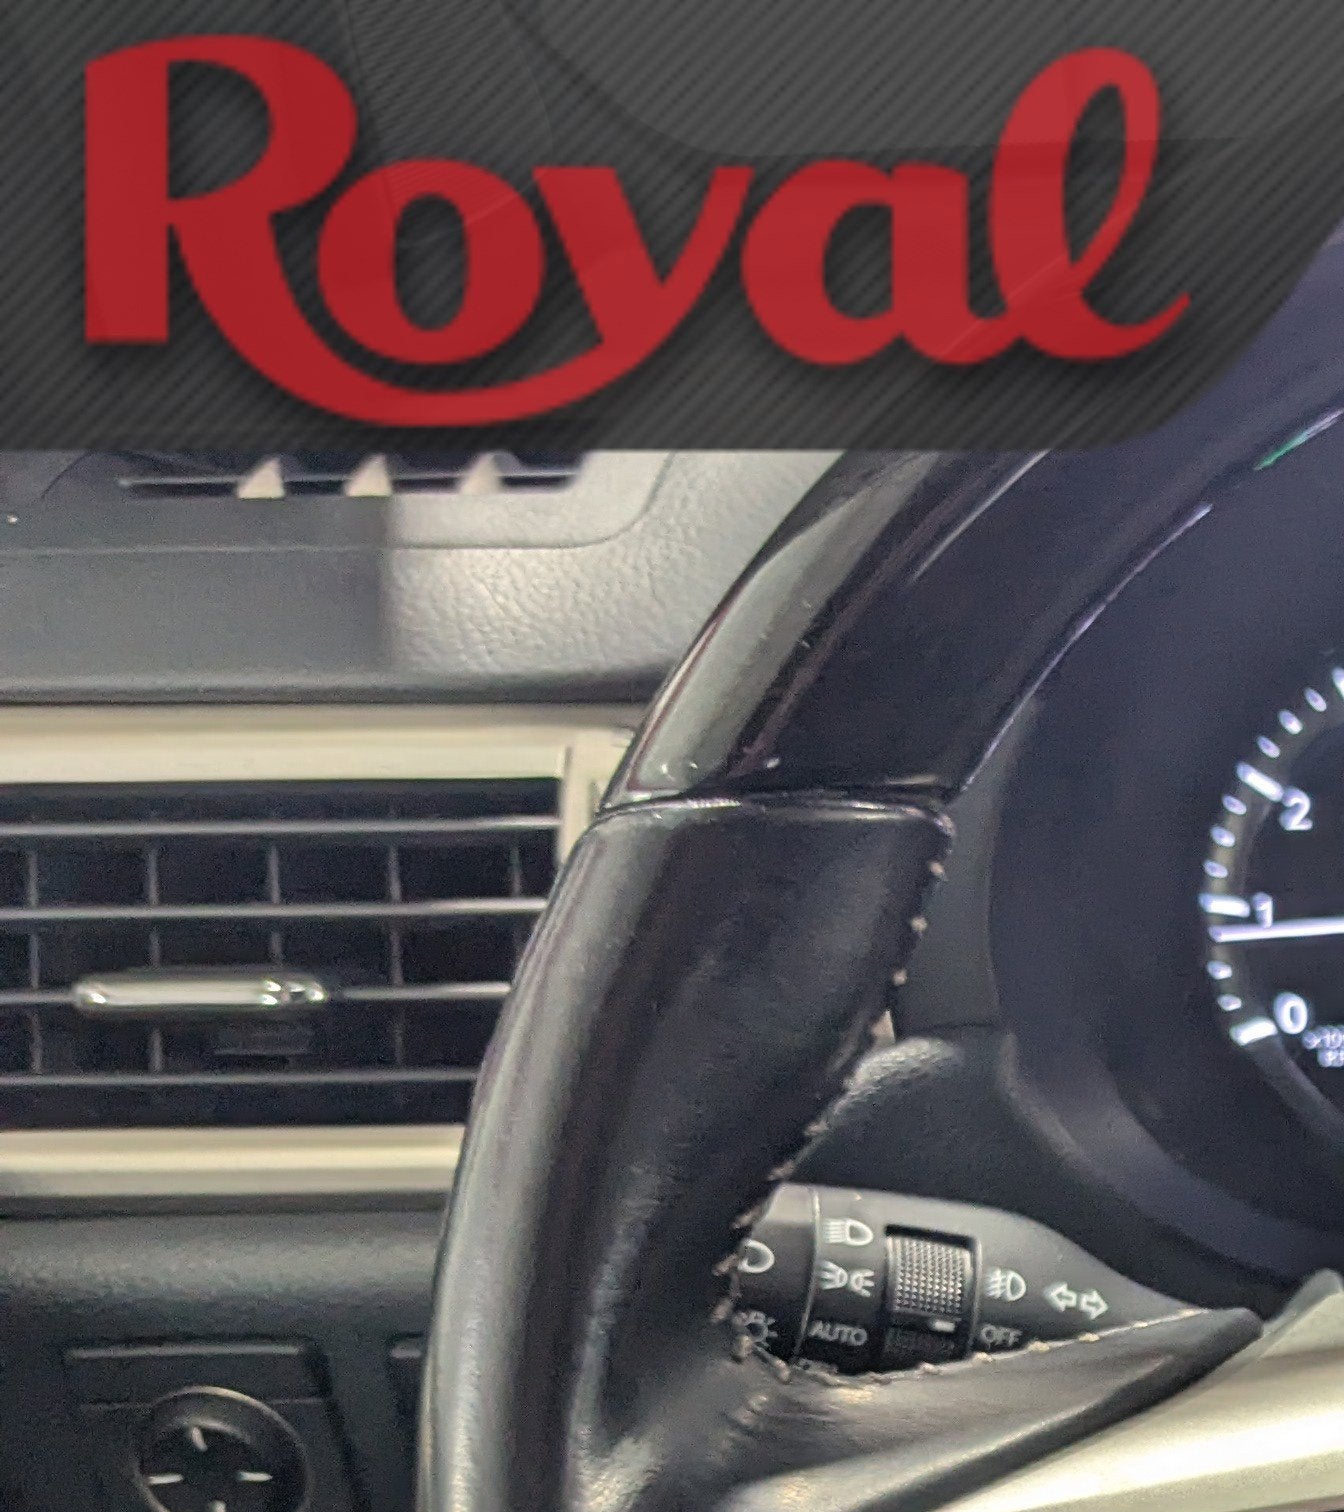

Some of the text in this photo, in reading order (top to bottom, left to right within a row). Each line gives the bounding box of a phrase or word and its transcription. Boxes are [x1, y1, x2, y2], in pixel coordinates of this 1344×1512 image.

[1281, 787, 1314, 831] 2
[1252, 892, 1273, 928] 1
[1273, 992, 1308, 1034] 0
[808, 1320, 868, 1347] AUTO
[980, 1324, 1023, 1347] OFF
